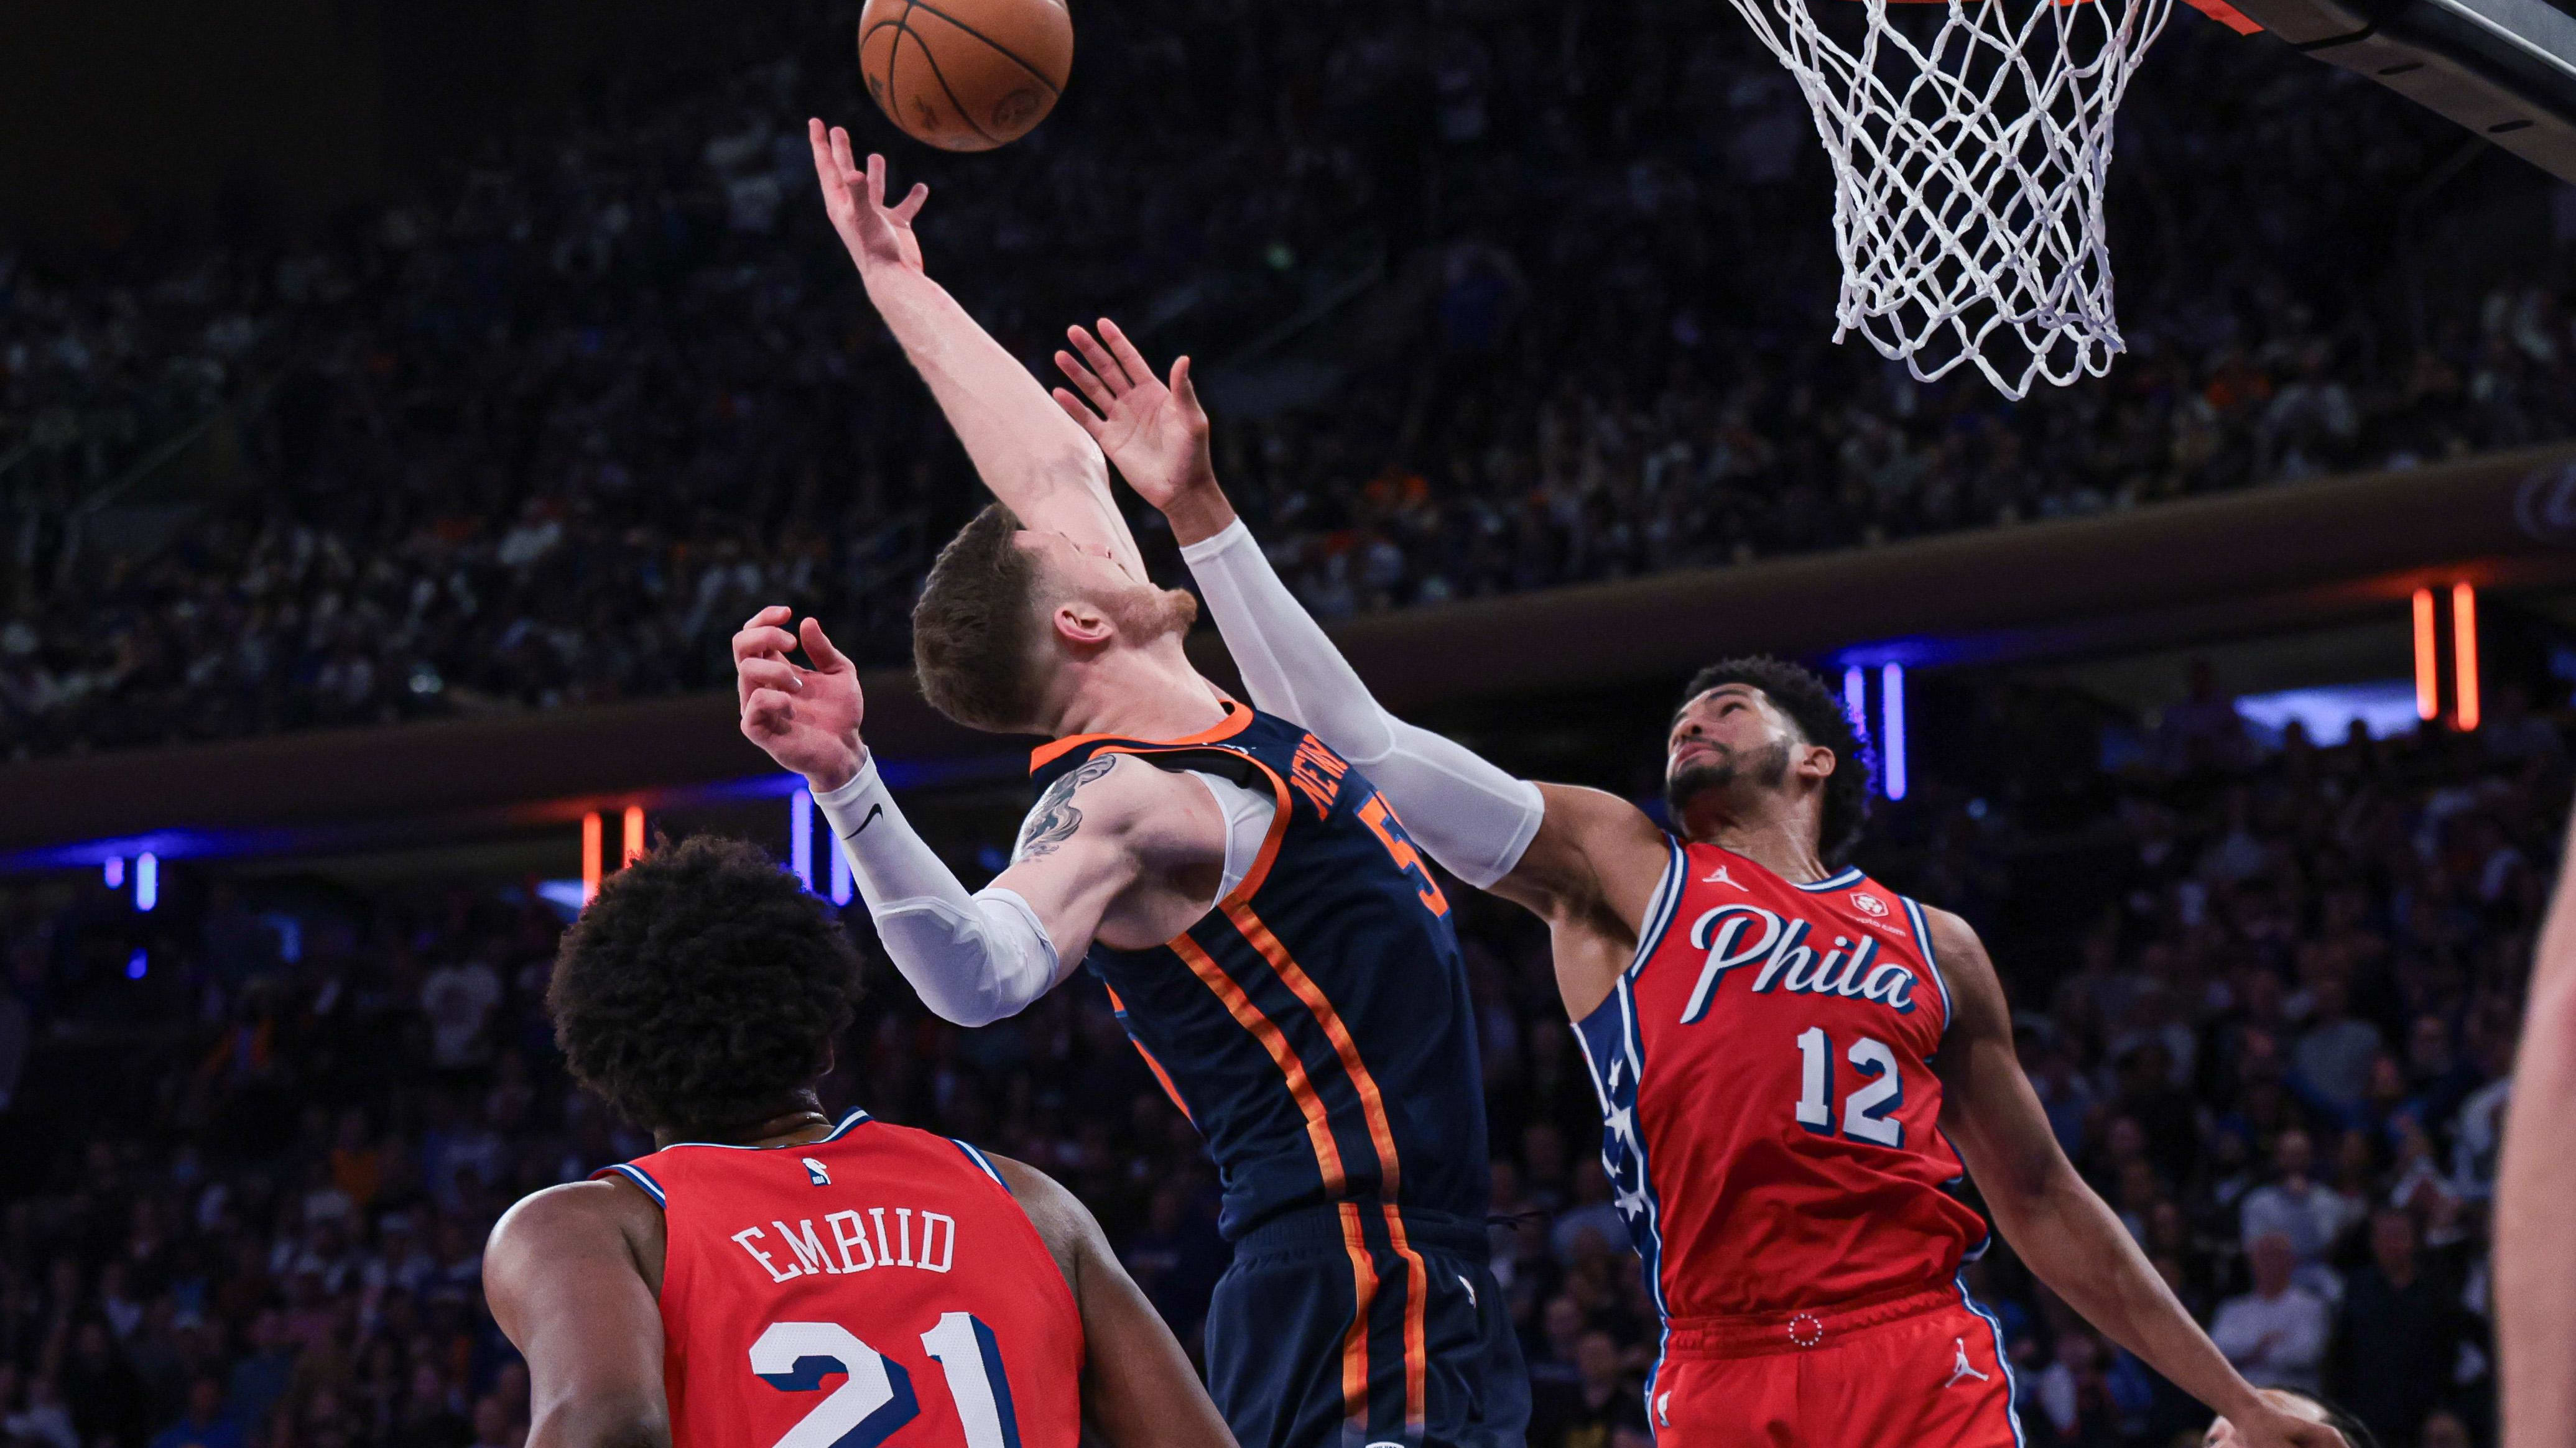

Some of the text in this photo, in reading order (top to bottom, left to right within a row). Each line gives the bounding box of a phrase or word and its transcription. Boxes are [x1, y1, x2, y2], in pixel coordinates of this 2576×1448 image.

[1680, 903, 1914, 1024] Phila
[1796, 1026, 1903, 1148] 12
[731, 1207, 955, 1283] EMBIID
[749, 1312, 1017, 1448] 21
